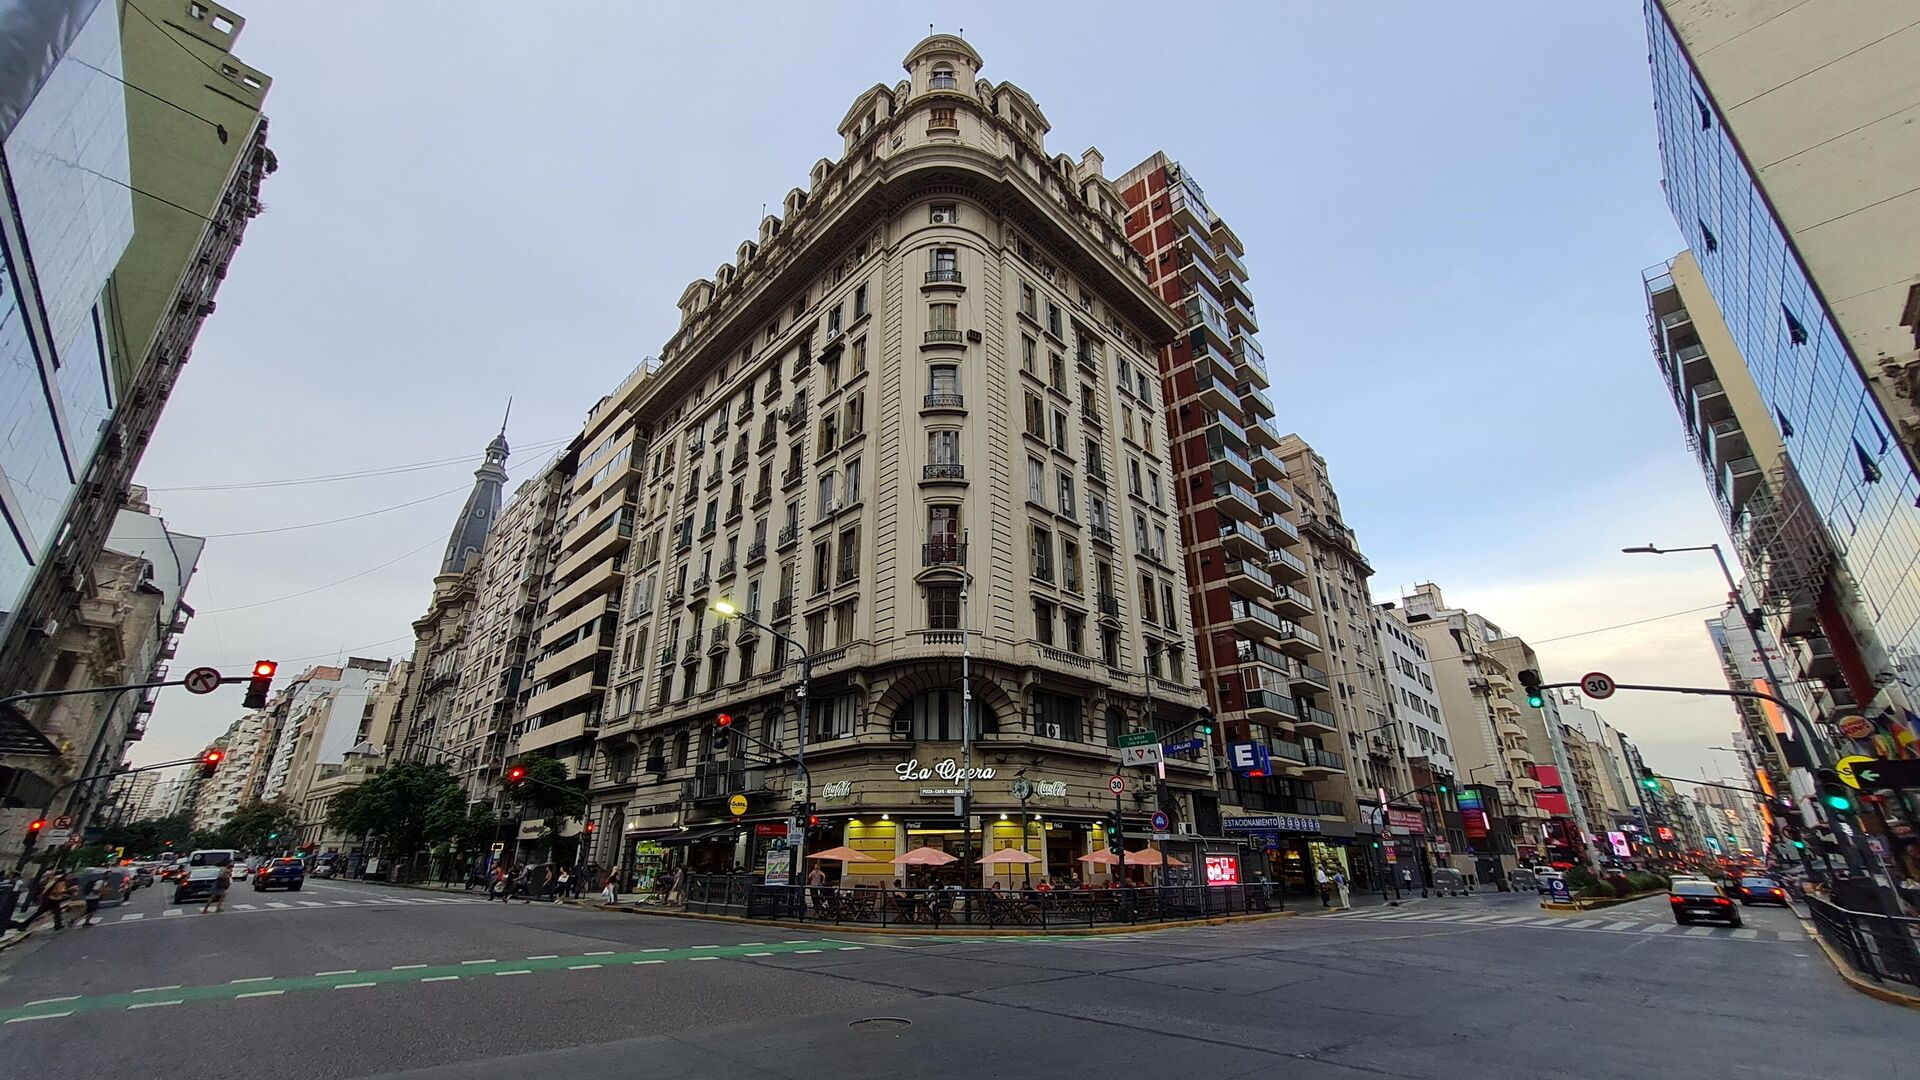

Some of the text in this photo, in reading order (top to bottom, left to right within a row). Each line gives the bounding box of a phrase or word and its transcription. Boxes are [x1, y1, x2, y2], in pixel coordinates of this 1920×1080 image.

[1587, 680, 1608, 692] 30
[1173, 742, 1191, 750] CALLAO
[744, 753, 770, 763] CORRIENTES
[1234, 744, 1254, 767] E
[895, 759, 997, 786] La Opera
[1112, 781, 1121, 789] 30
[1224, 818, 1278, 827] ESTACIONAMIENTO
